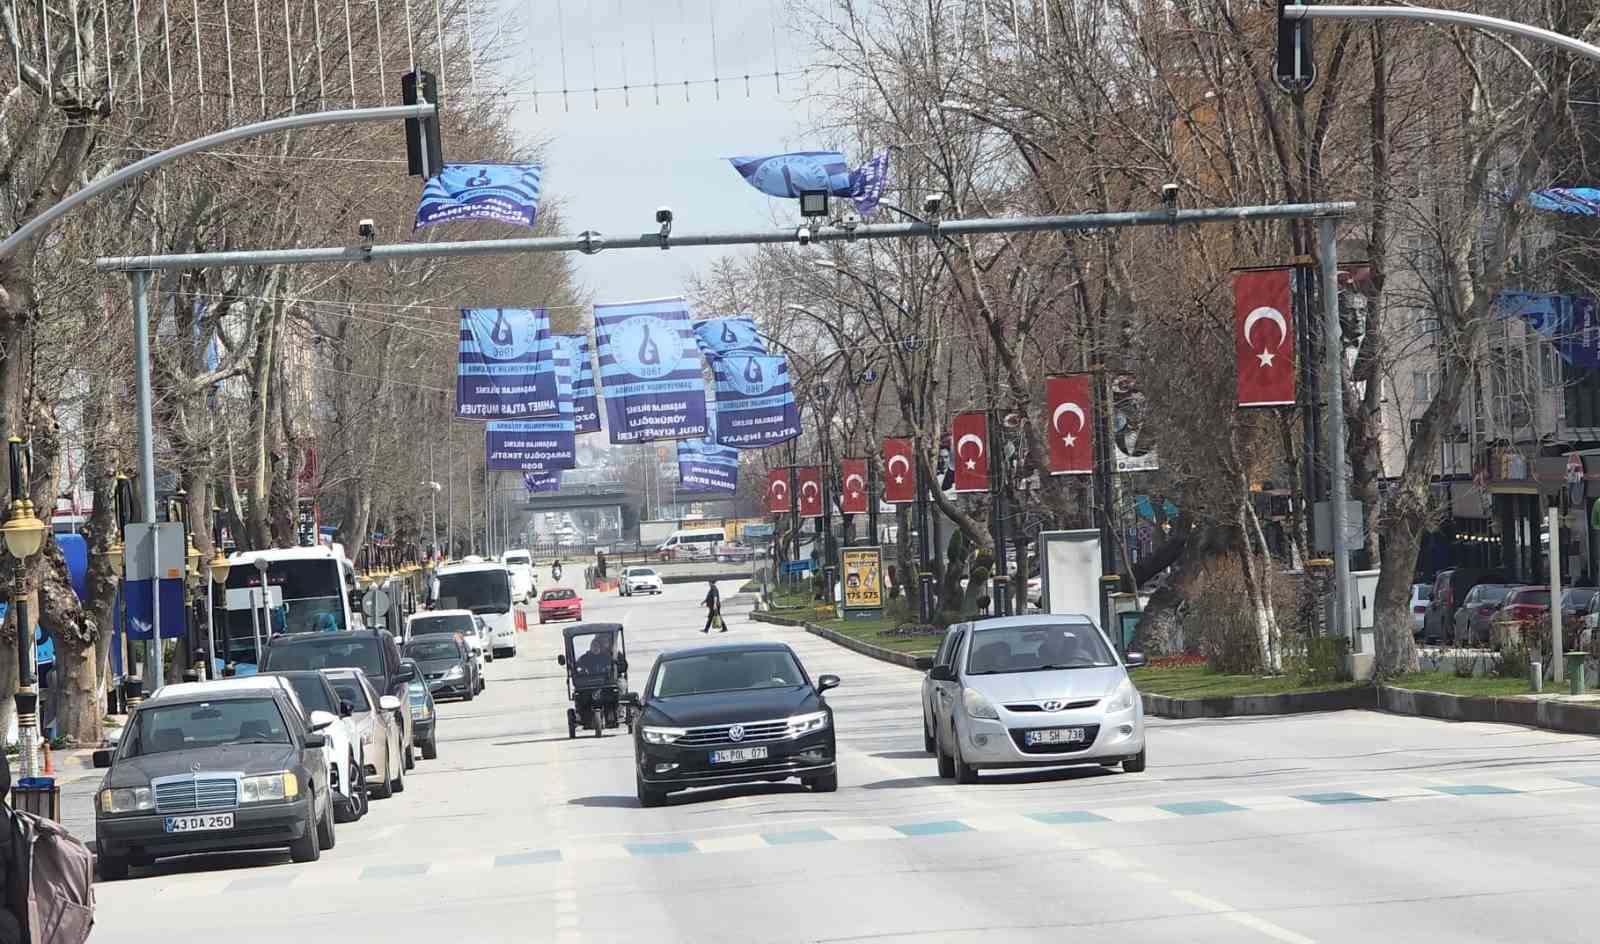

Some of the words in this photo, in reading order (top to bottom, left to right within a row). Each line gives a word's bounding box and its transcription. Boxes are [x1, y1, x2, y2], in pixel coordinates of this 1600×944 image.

[173, 818, 188, 830] 43
[190, 818, 206, 830] DA
[208, 815, 232, 828] 250
